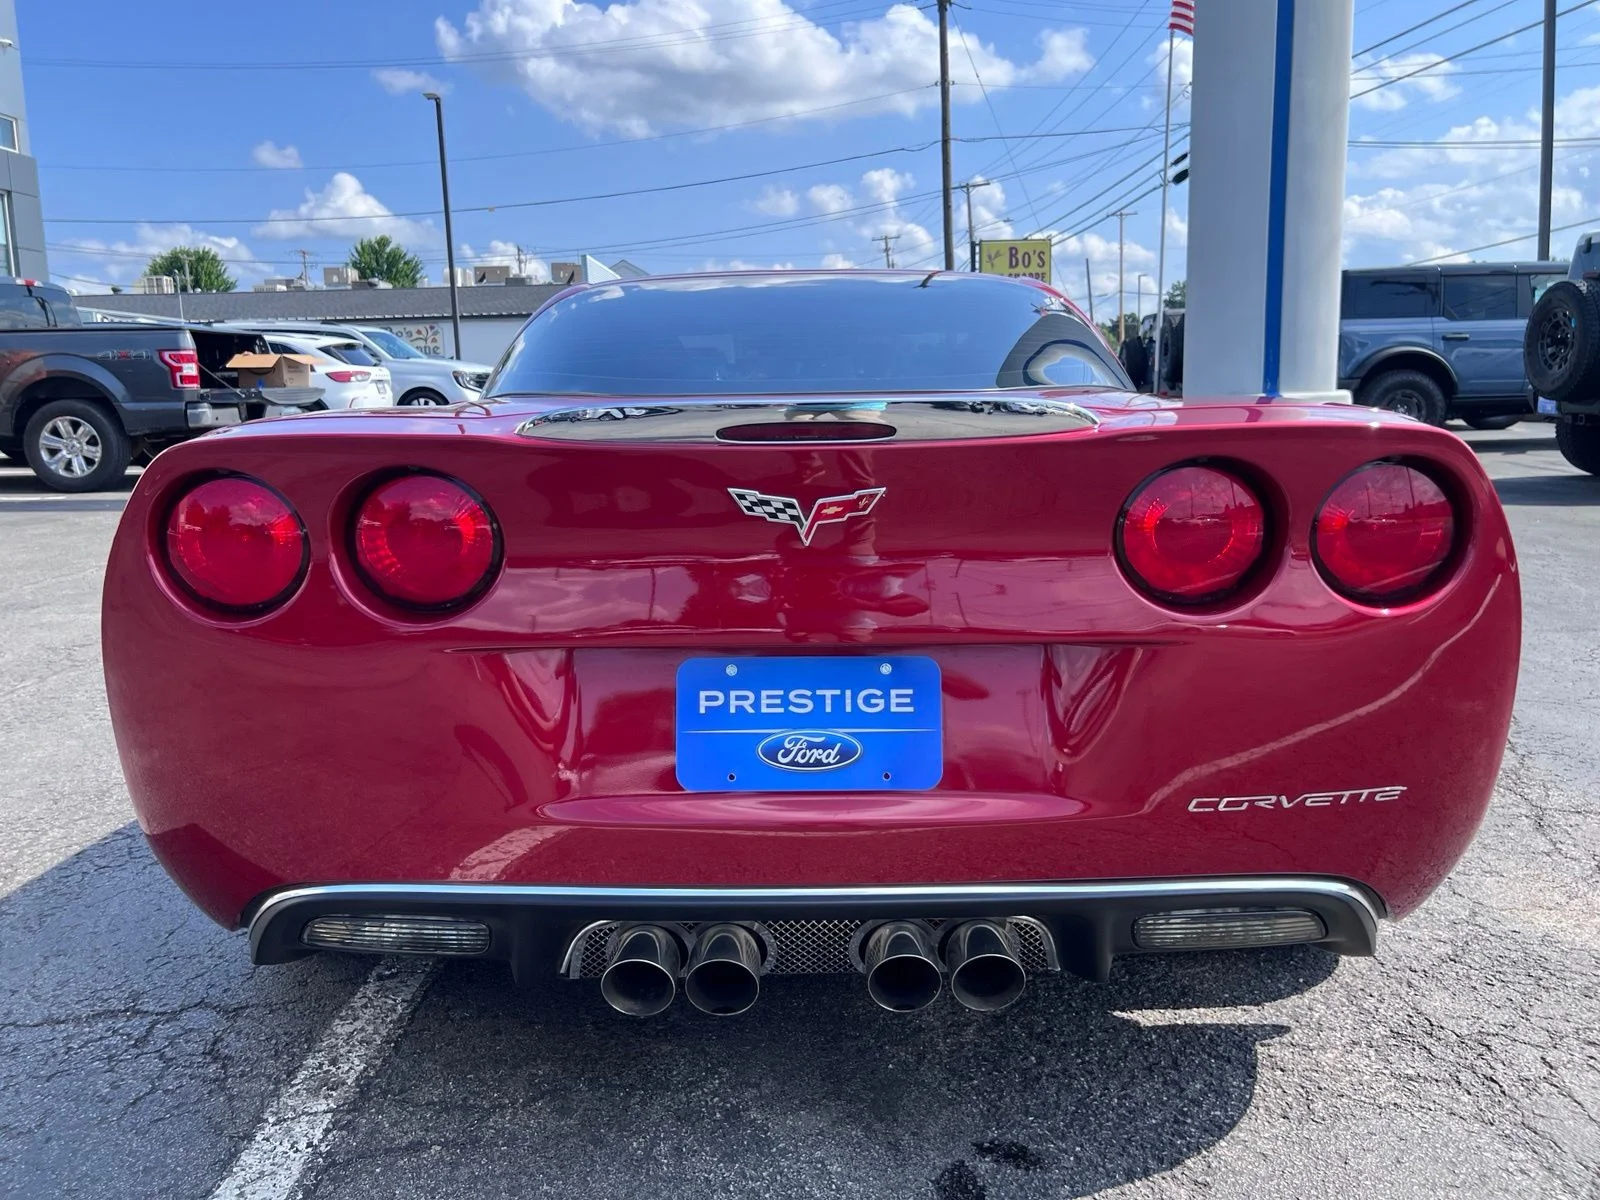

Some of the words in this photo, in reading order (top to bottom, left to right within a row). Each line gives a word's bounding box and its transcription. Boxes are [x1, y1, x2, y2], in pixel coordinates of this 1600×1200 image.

[698, 688, 915, 714] PRESTIGE
[777, 735, 841, 765] Ford
[1187, 785, 1408, 812] CORVETTE
